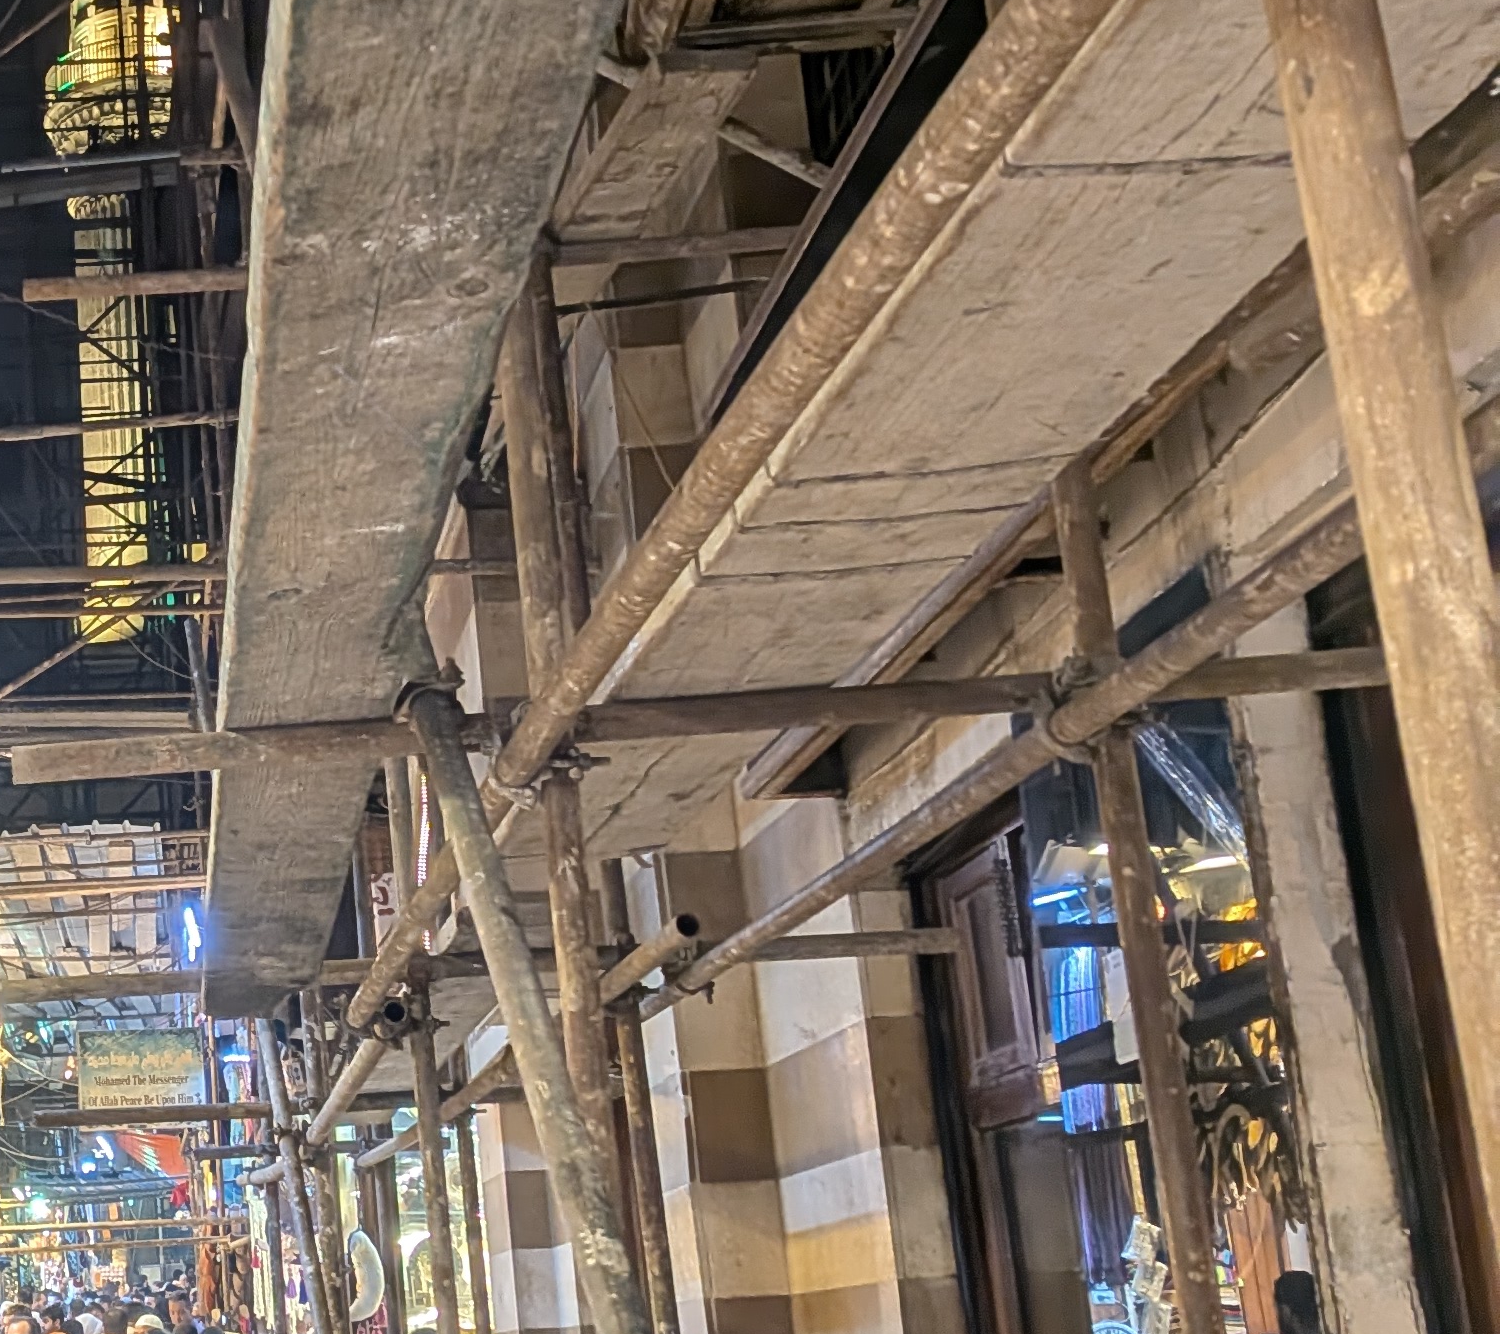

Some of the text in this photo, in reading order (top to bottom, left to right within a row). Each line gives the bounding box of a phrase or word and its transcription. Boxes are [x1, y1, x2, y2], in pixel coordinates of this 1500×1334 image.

[93, 1074, 190, 1087] Mohamed The Messenger
[88, 1093, 193, 1107] Of Allah Peace Be Upon Him
